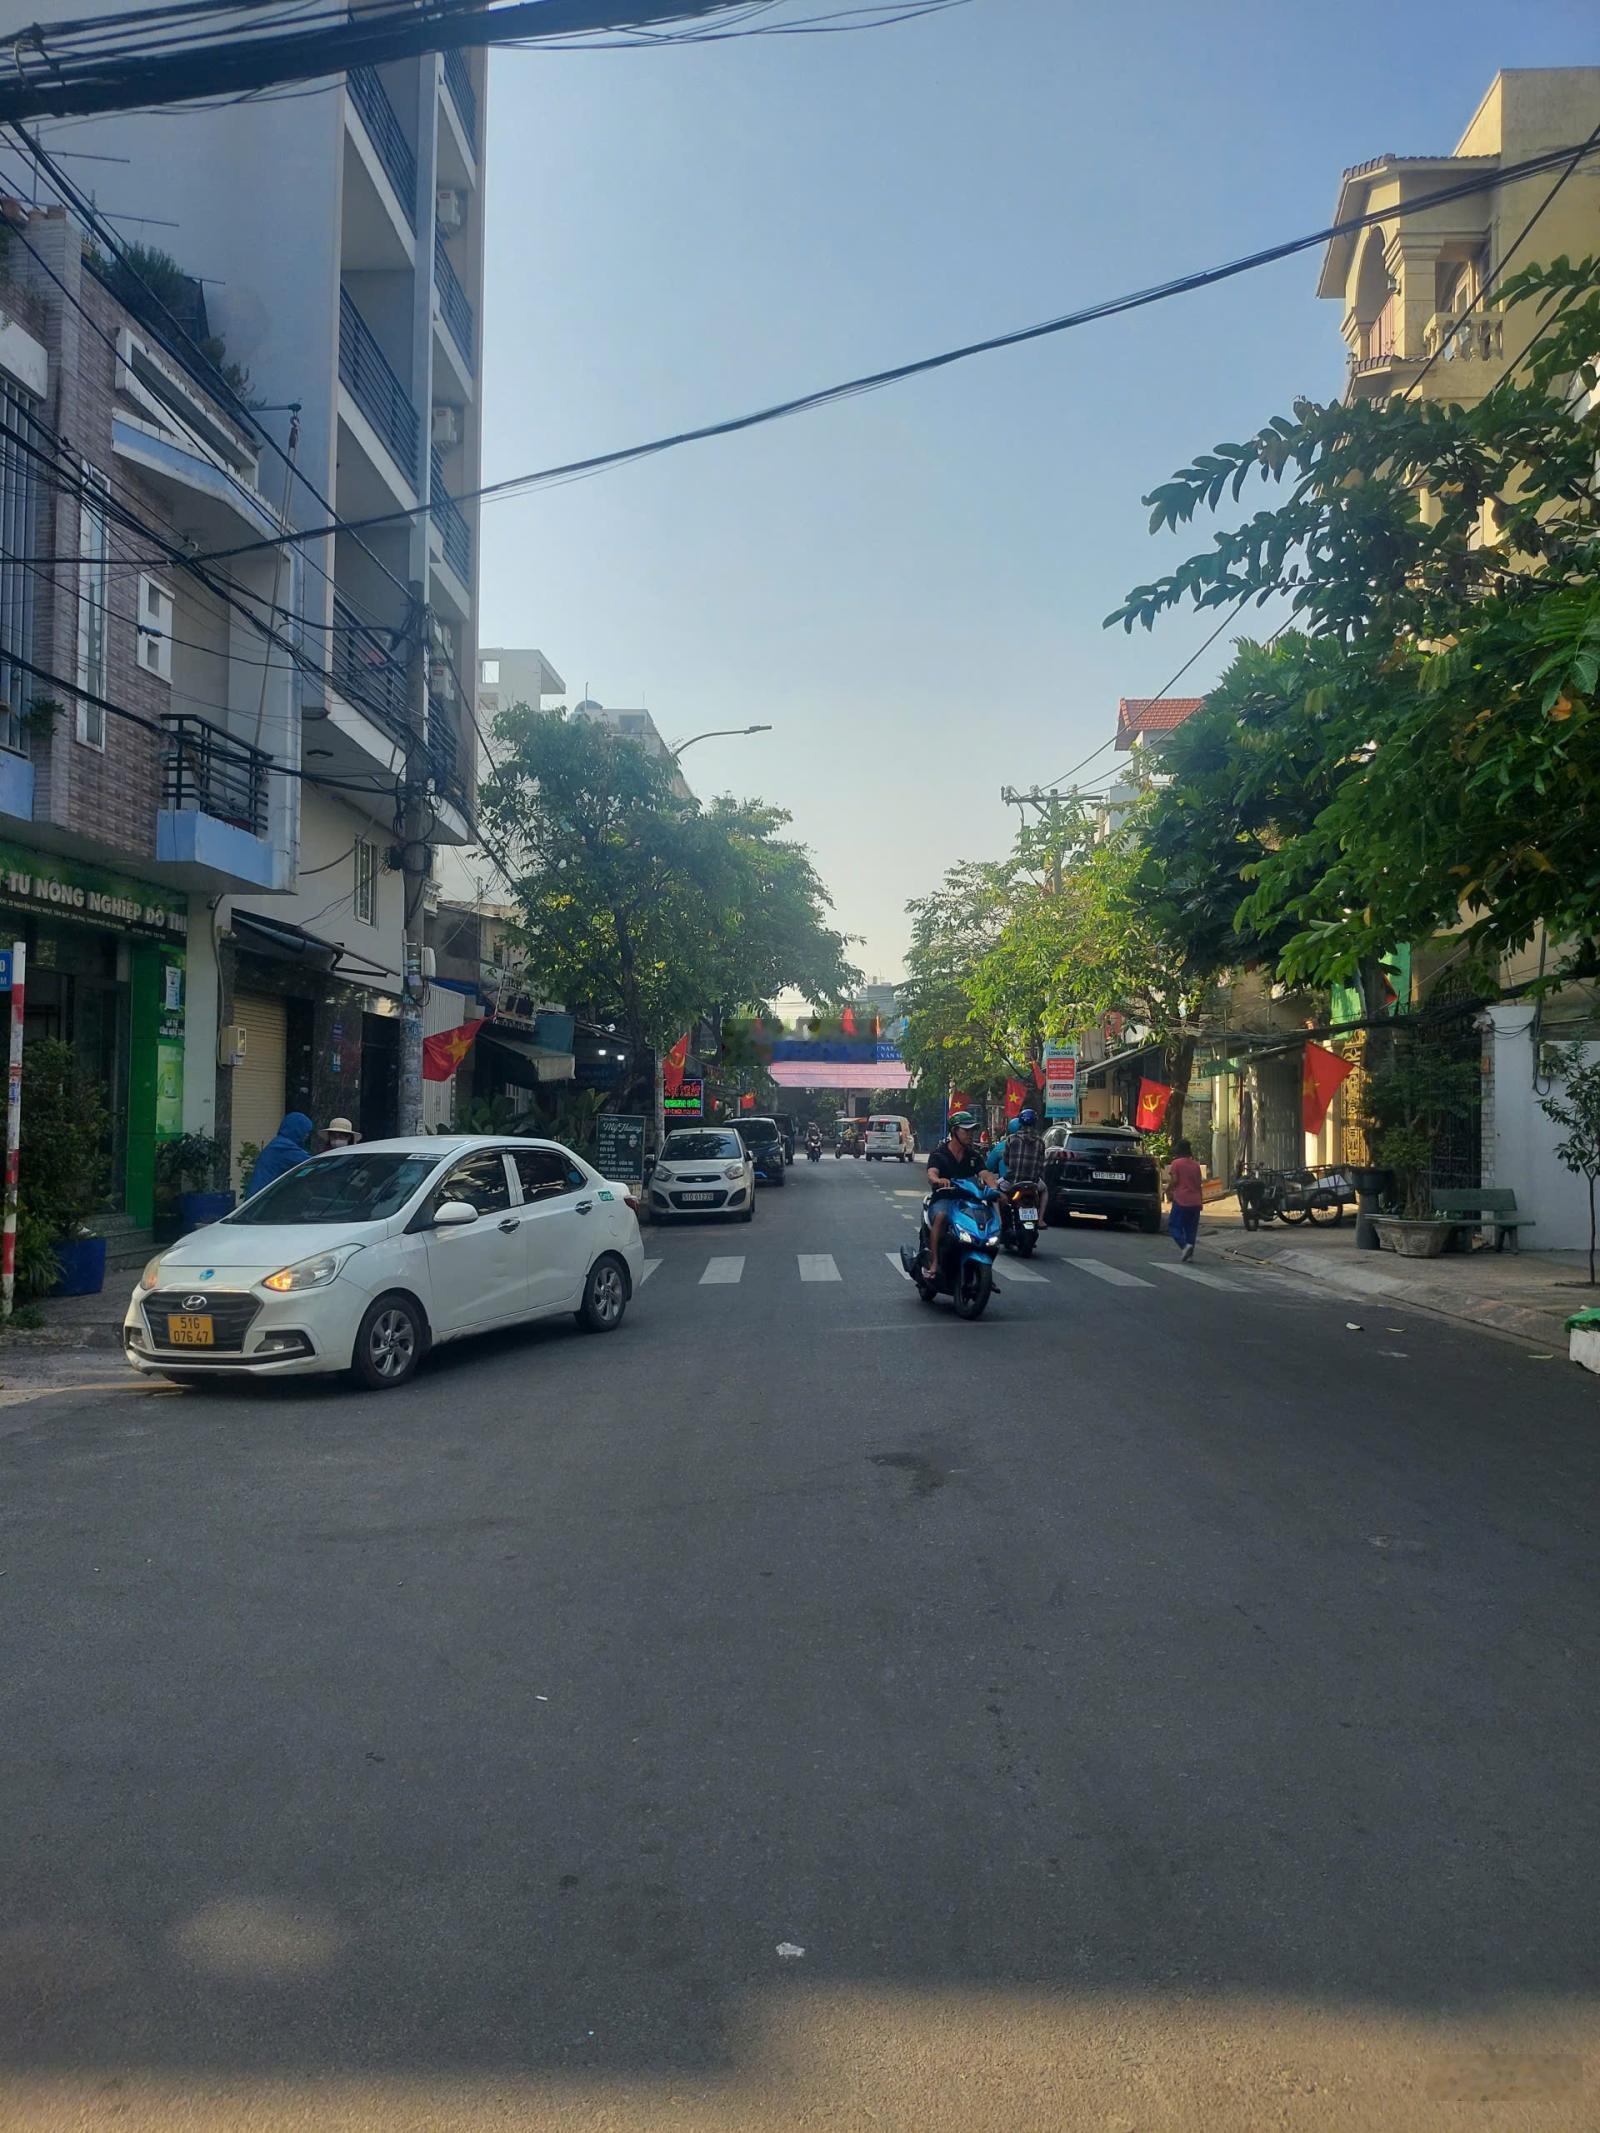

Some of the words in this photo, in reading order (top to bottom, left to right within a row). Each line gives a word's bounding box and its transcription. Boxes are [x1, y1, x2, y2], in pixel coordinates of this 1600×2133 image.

[34, 876, 84, 907] NÔNG
[88, 890, 142, 923] NGHIỆP
[180, 1317, 200, 1329] 51G
[173, 1330, 209, 1343] 076.47
